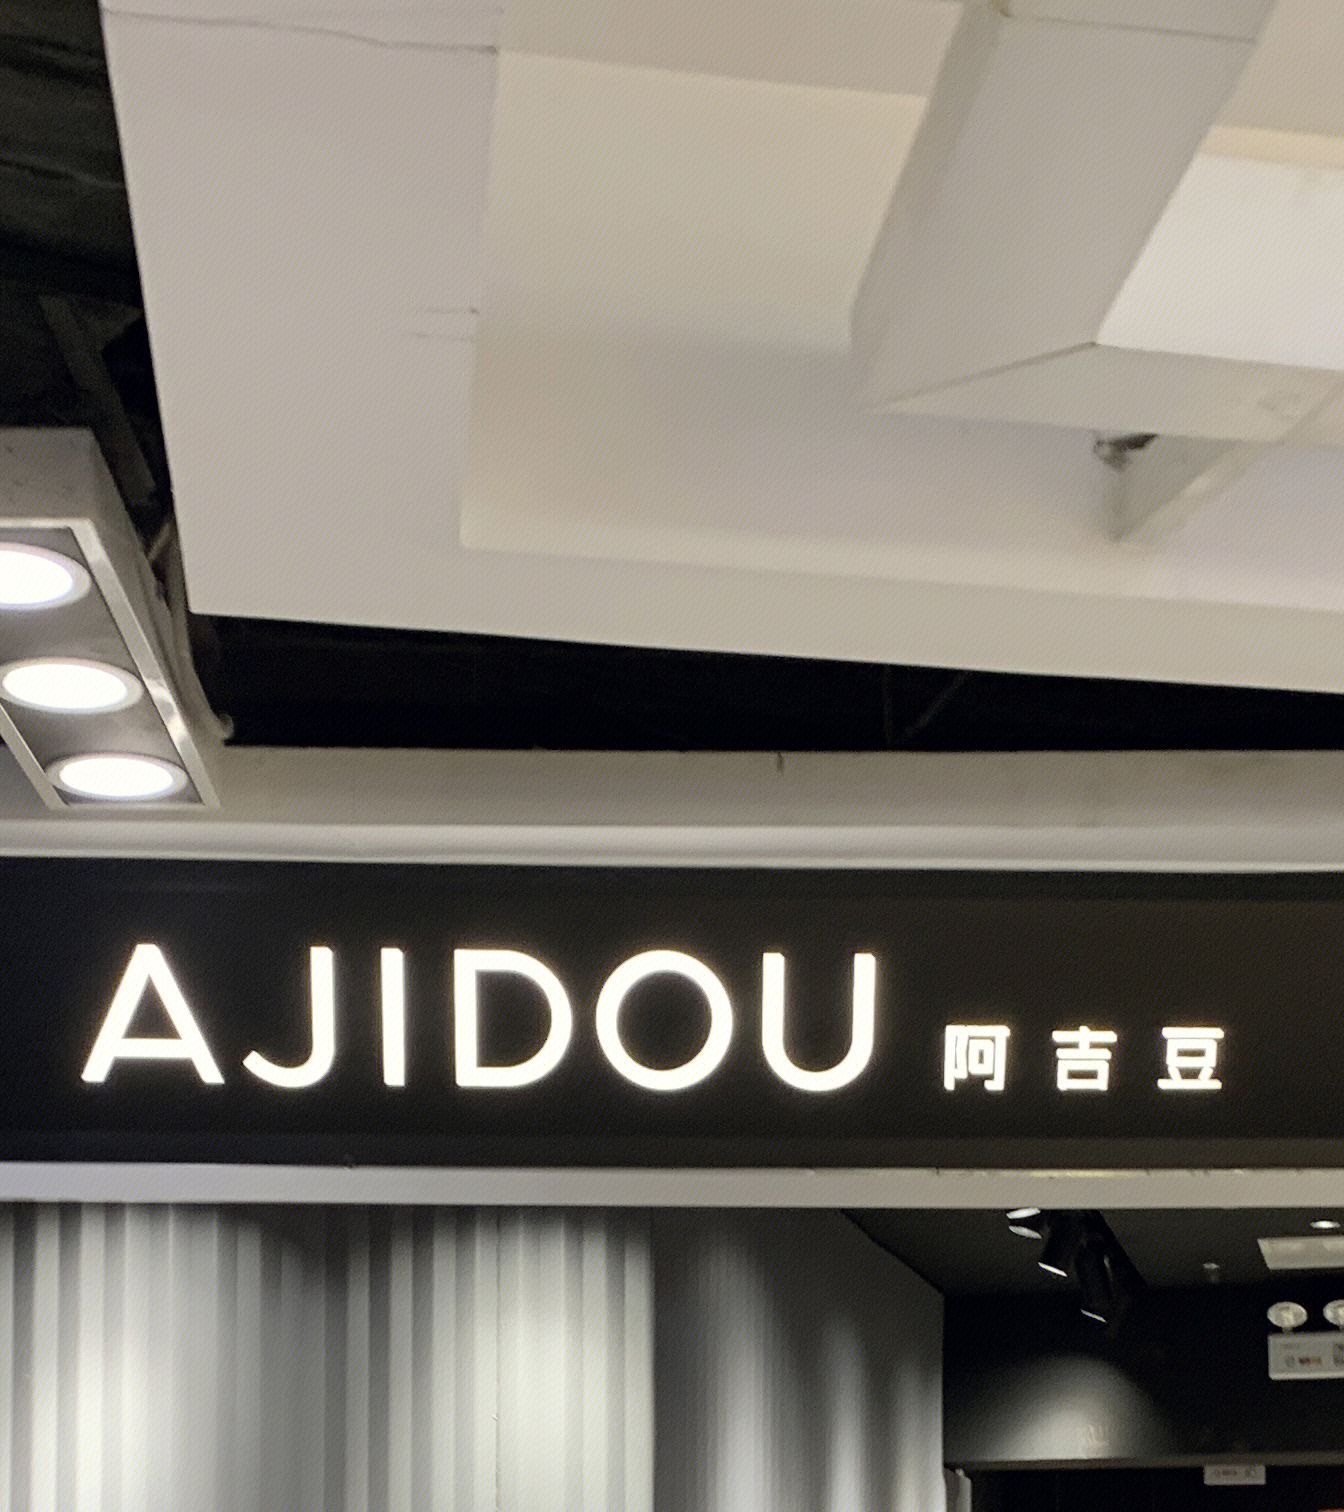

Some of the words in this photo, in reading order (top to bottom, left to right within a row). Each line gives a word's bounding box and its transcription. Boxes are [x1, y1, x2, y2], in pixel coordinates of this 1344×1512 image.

[80, 942, 878, 1093] AJIDOU
[942, 1023, 1226, 1092] 阿吉豆
